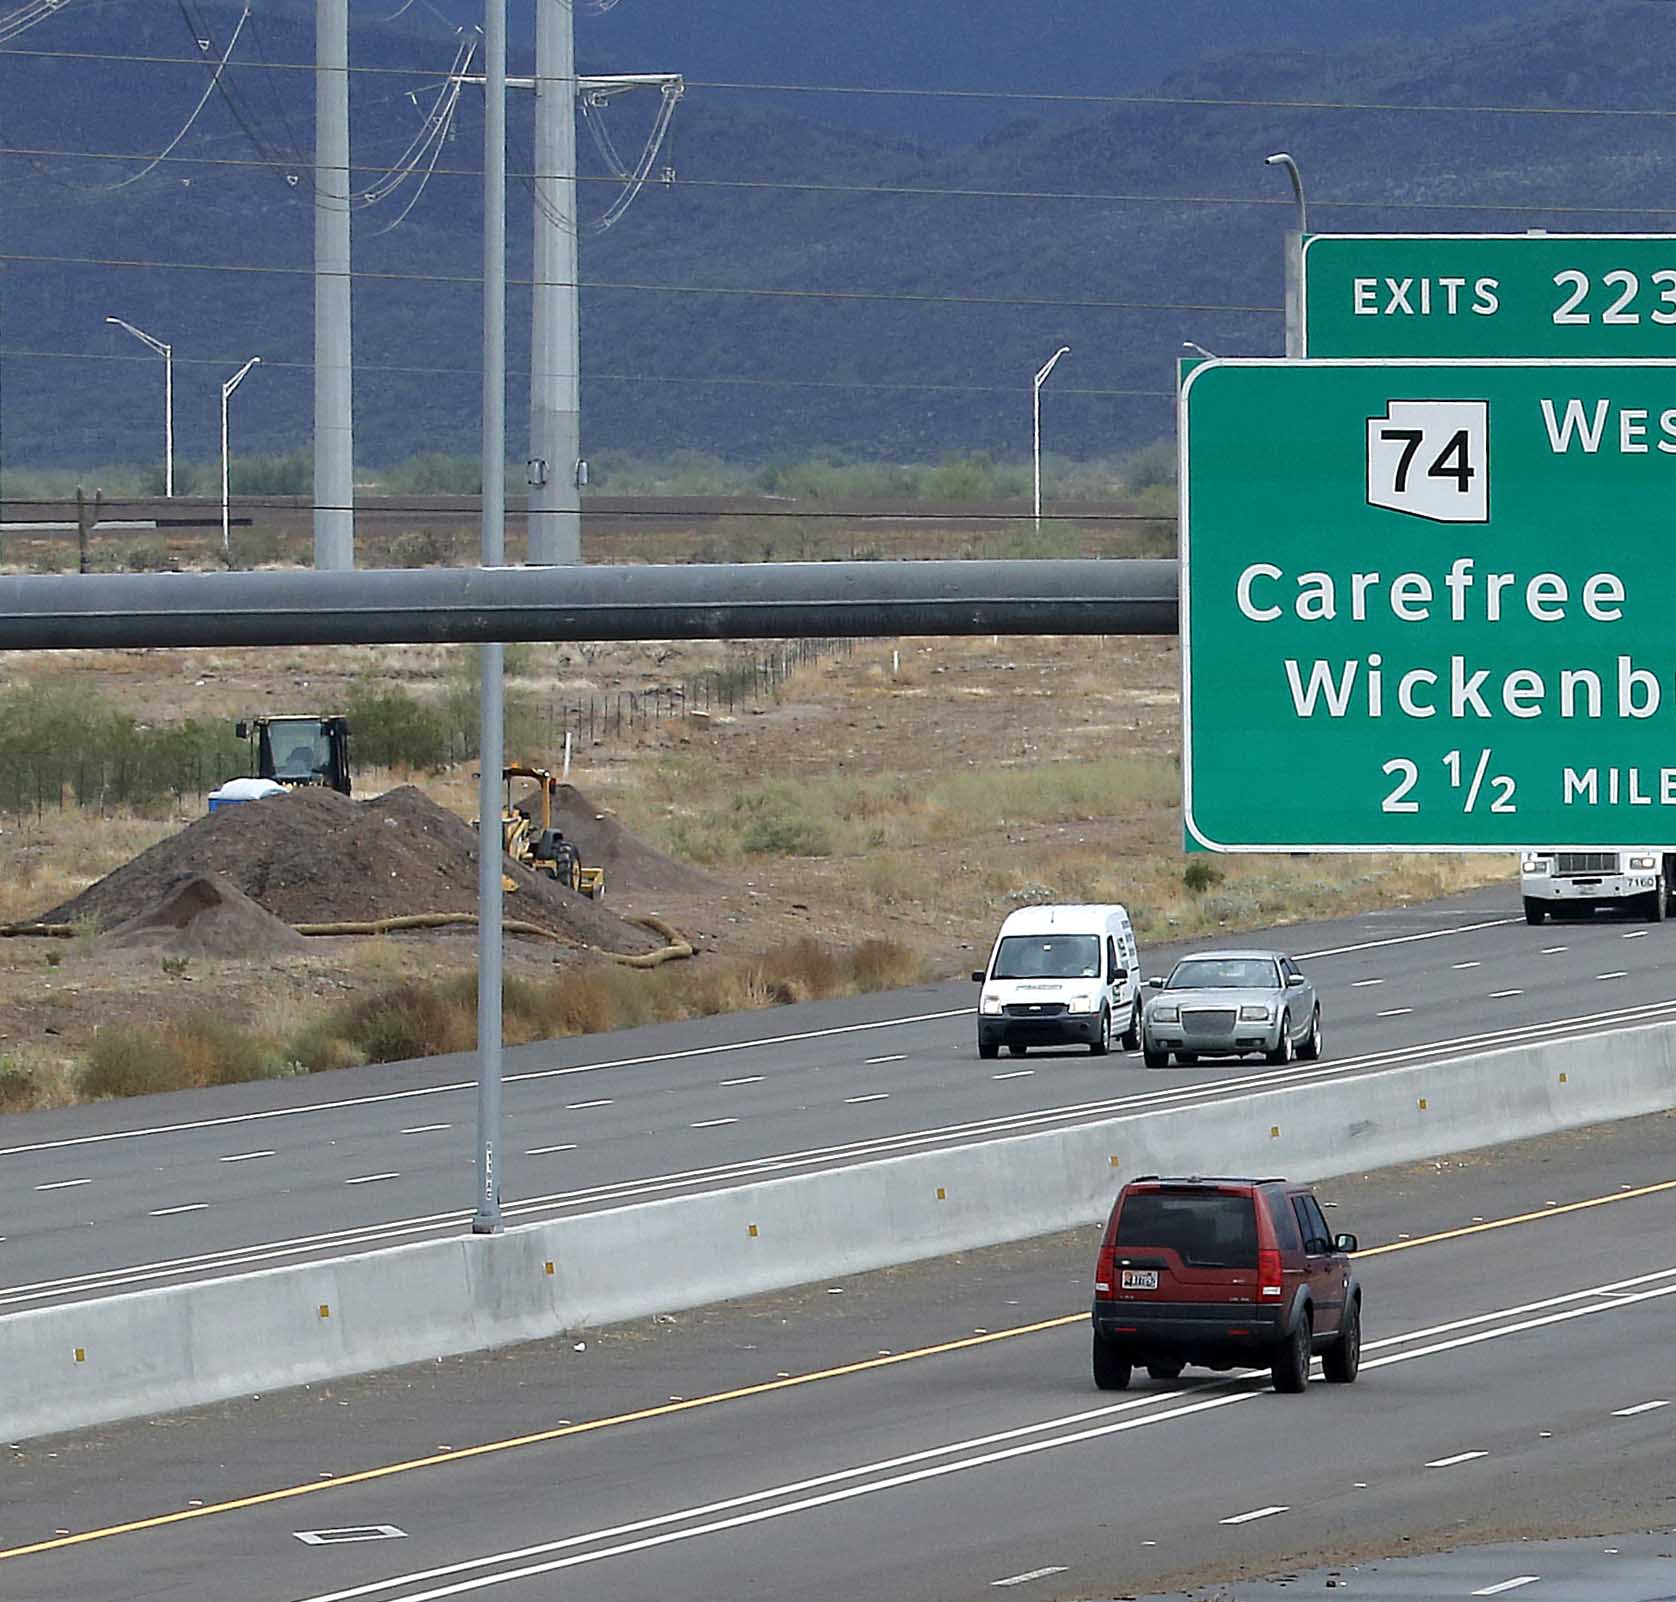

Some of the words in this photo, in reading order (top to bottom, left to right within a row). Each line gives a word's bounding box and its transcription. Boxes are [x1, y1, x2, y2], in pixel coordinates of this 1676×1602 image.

[1354, 278, 1499, 315] EXITS
[1381, 430, 1475, 493] 74
[1236, 559, 1627, 622] Carefree
